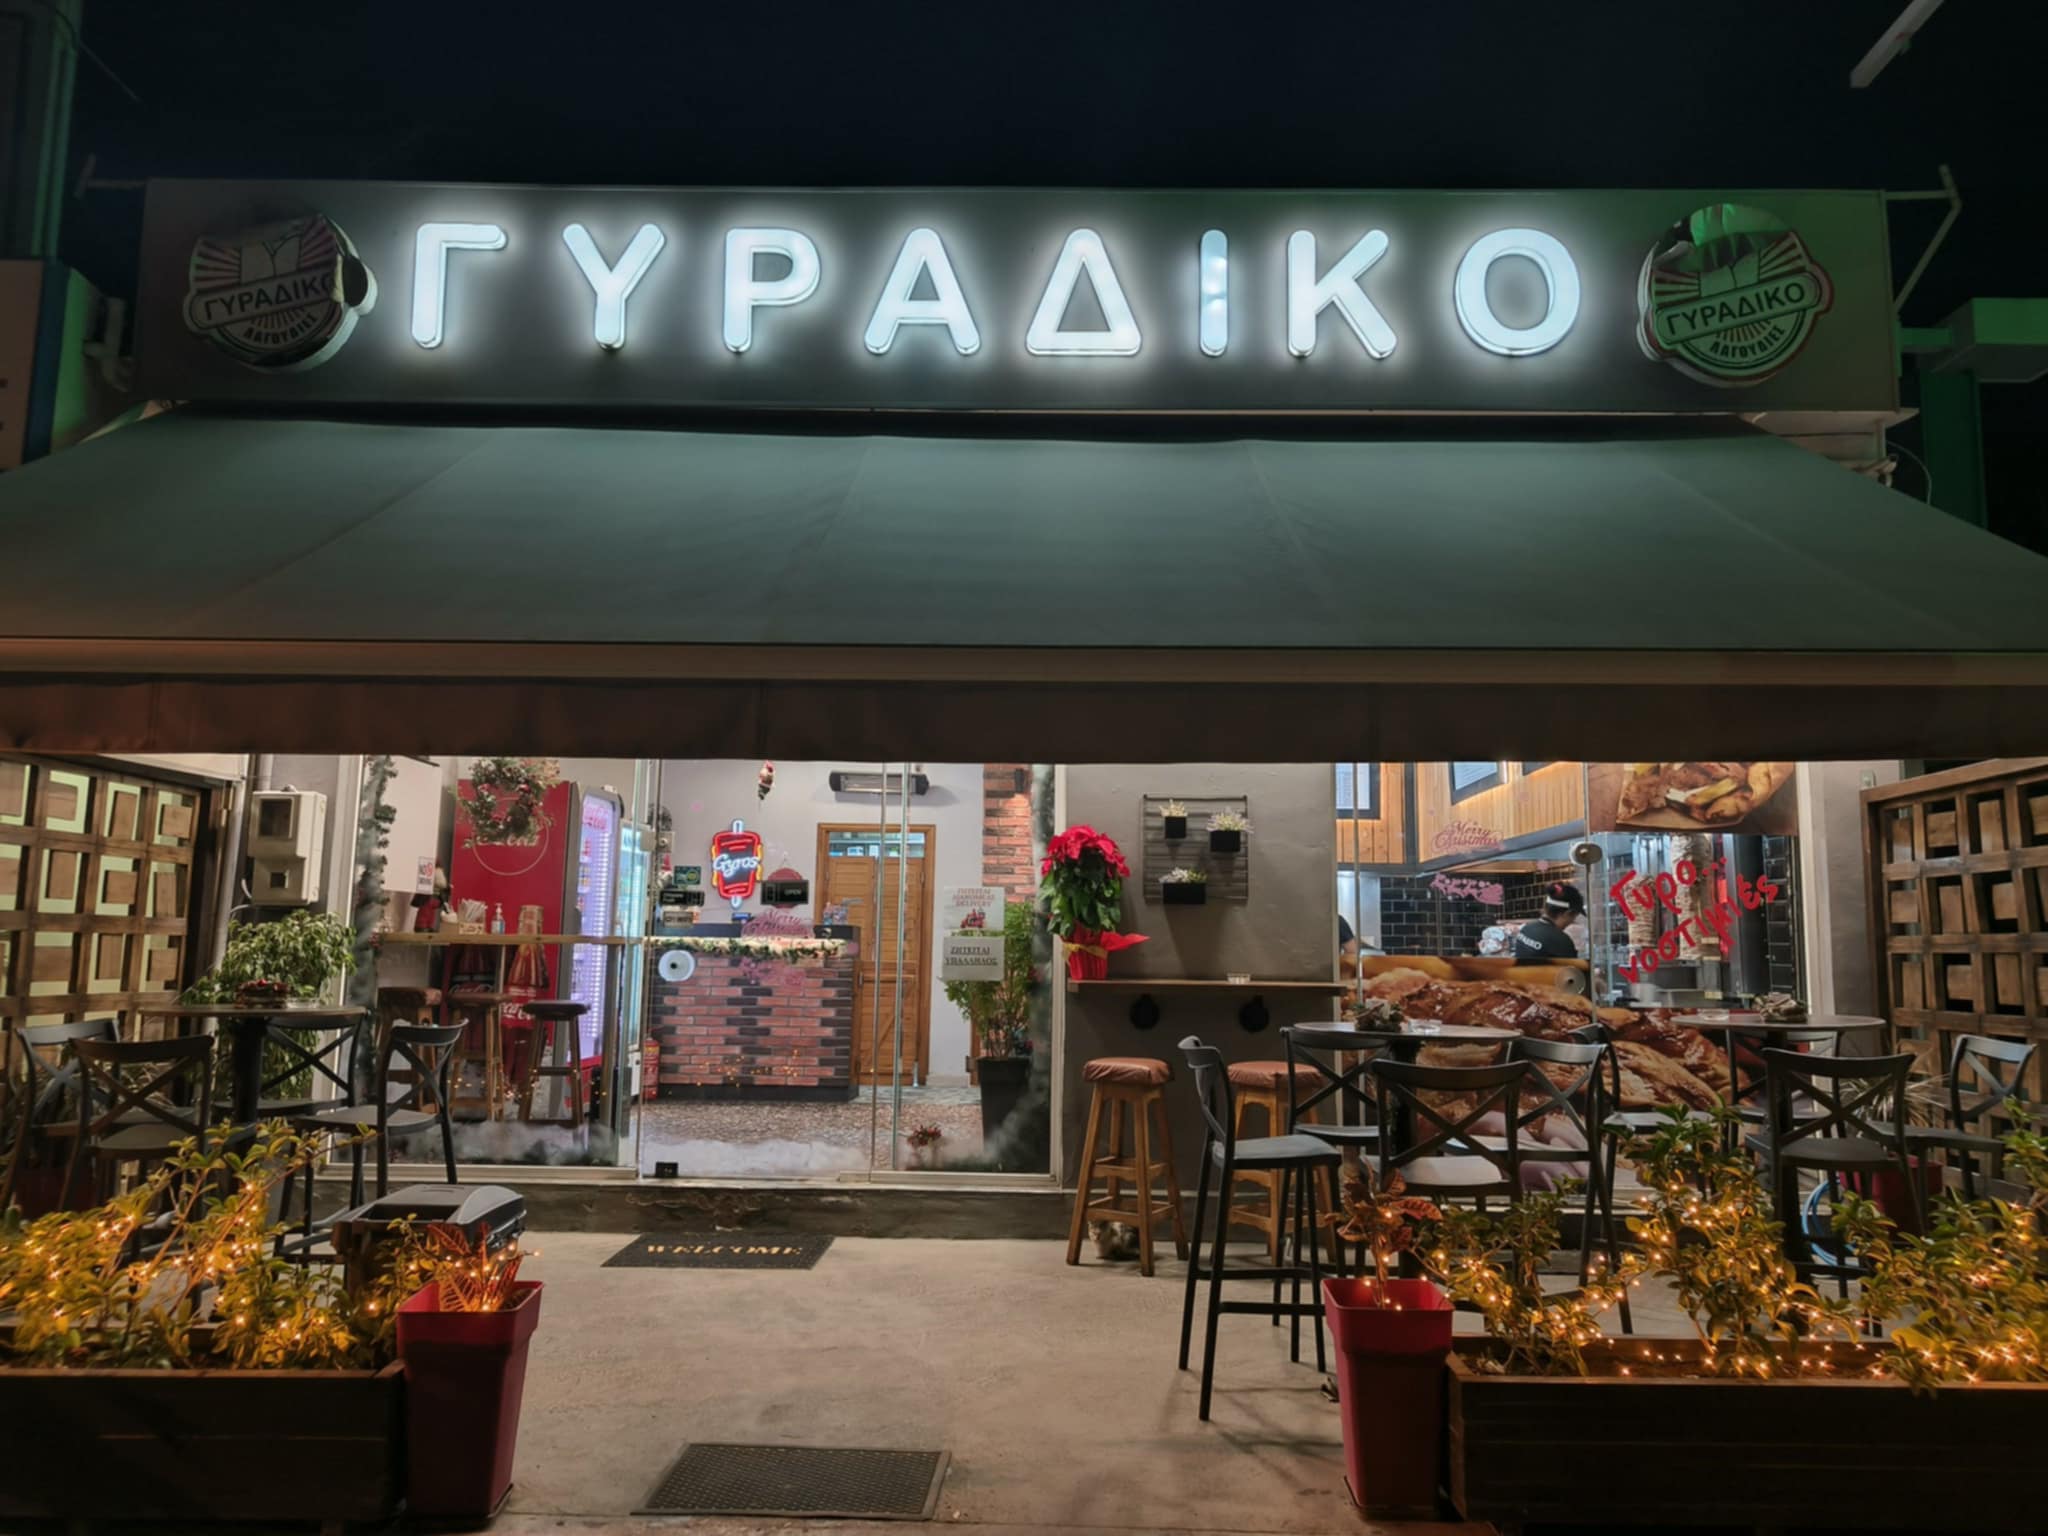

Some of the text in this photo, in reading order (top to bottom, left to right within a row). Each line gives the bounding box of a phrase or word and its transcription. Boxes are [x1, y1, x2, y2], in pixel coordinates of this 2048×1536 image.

[411, 222, 1581, 359] ΓΥΡΑΔΙΚΟ
[1666, 282, 1805, 335] ΓΥΡΑΔΙΚΟ
[713, 853, 760, 878] Gyros
